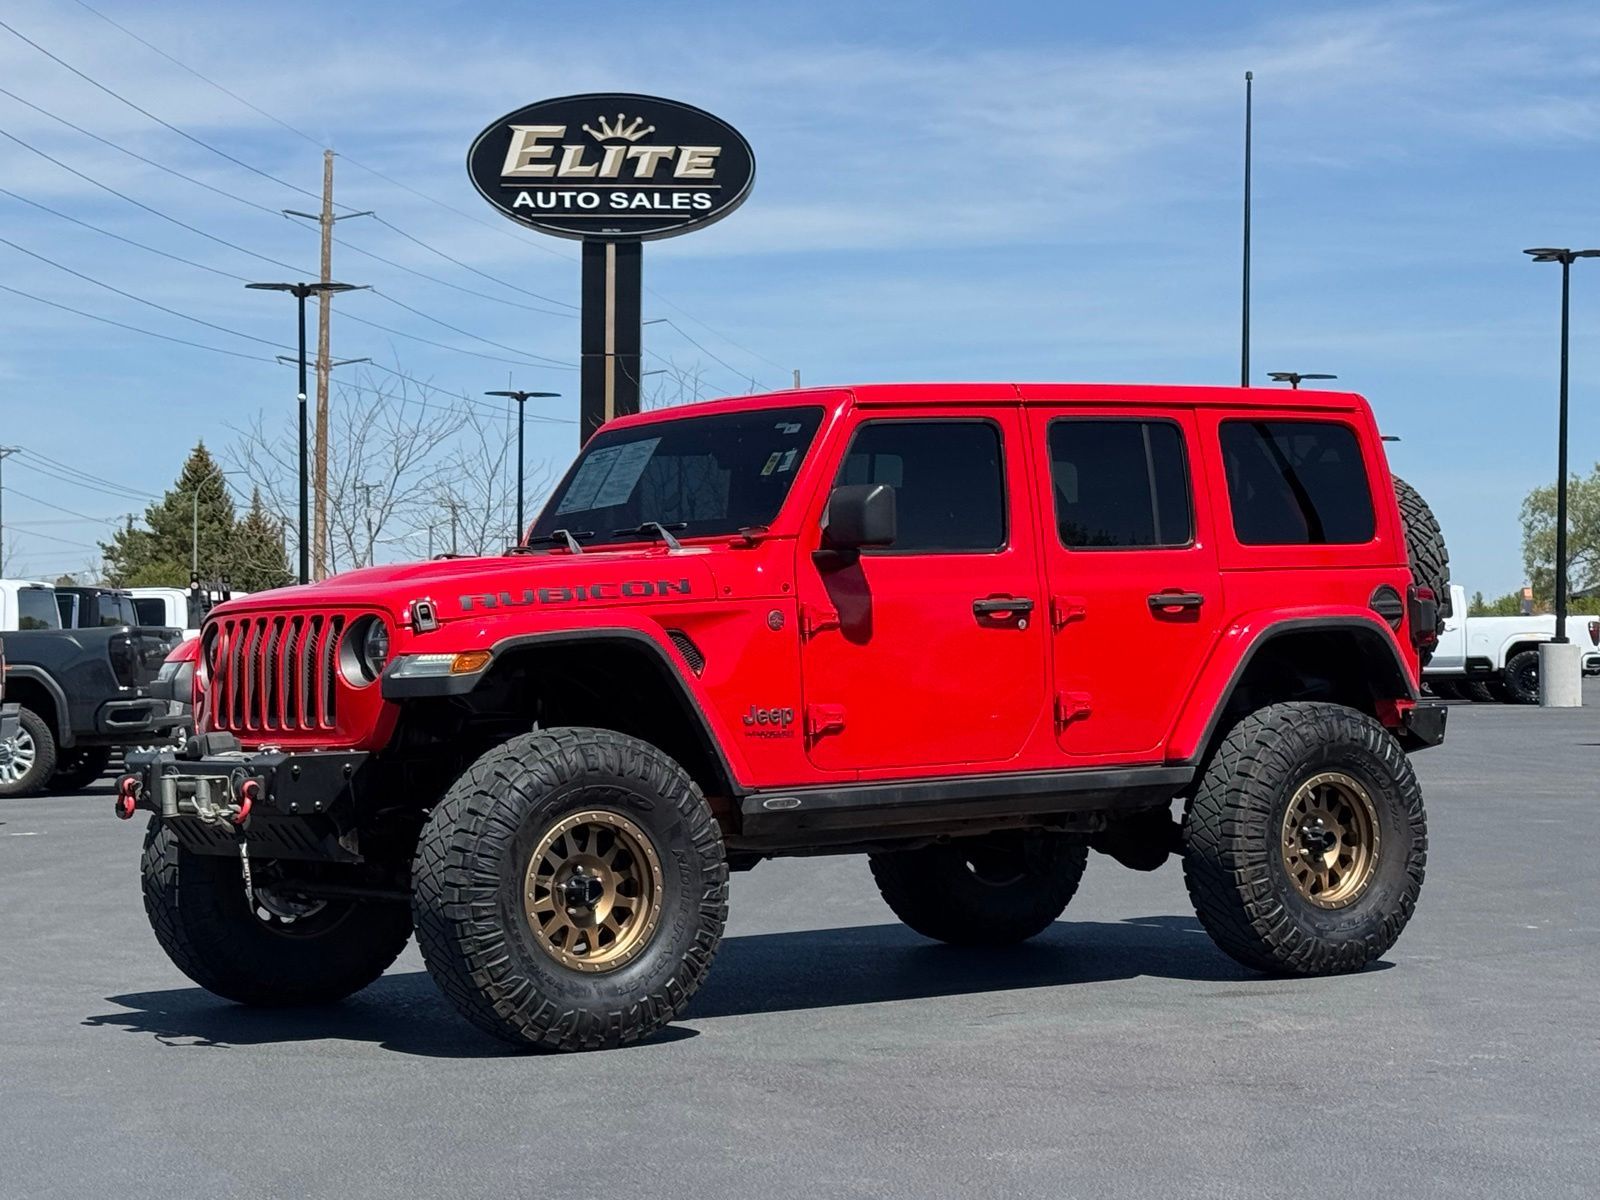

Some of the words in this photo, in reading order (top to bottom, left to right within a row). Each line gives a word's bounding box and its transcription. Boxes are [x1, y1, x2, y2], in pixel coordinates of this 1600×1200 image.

[500, 125, 722, 179] ELITE
[512, 191, 600, 209] AUTO
[609, 192, 712, 210] SALES
[459, 578, 692, 611] RUBICON
[743, 704, 794, 729] Jeep
